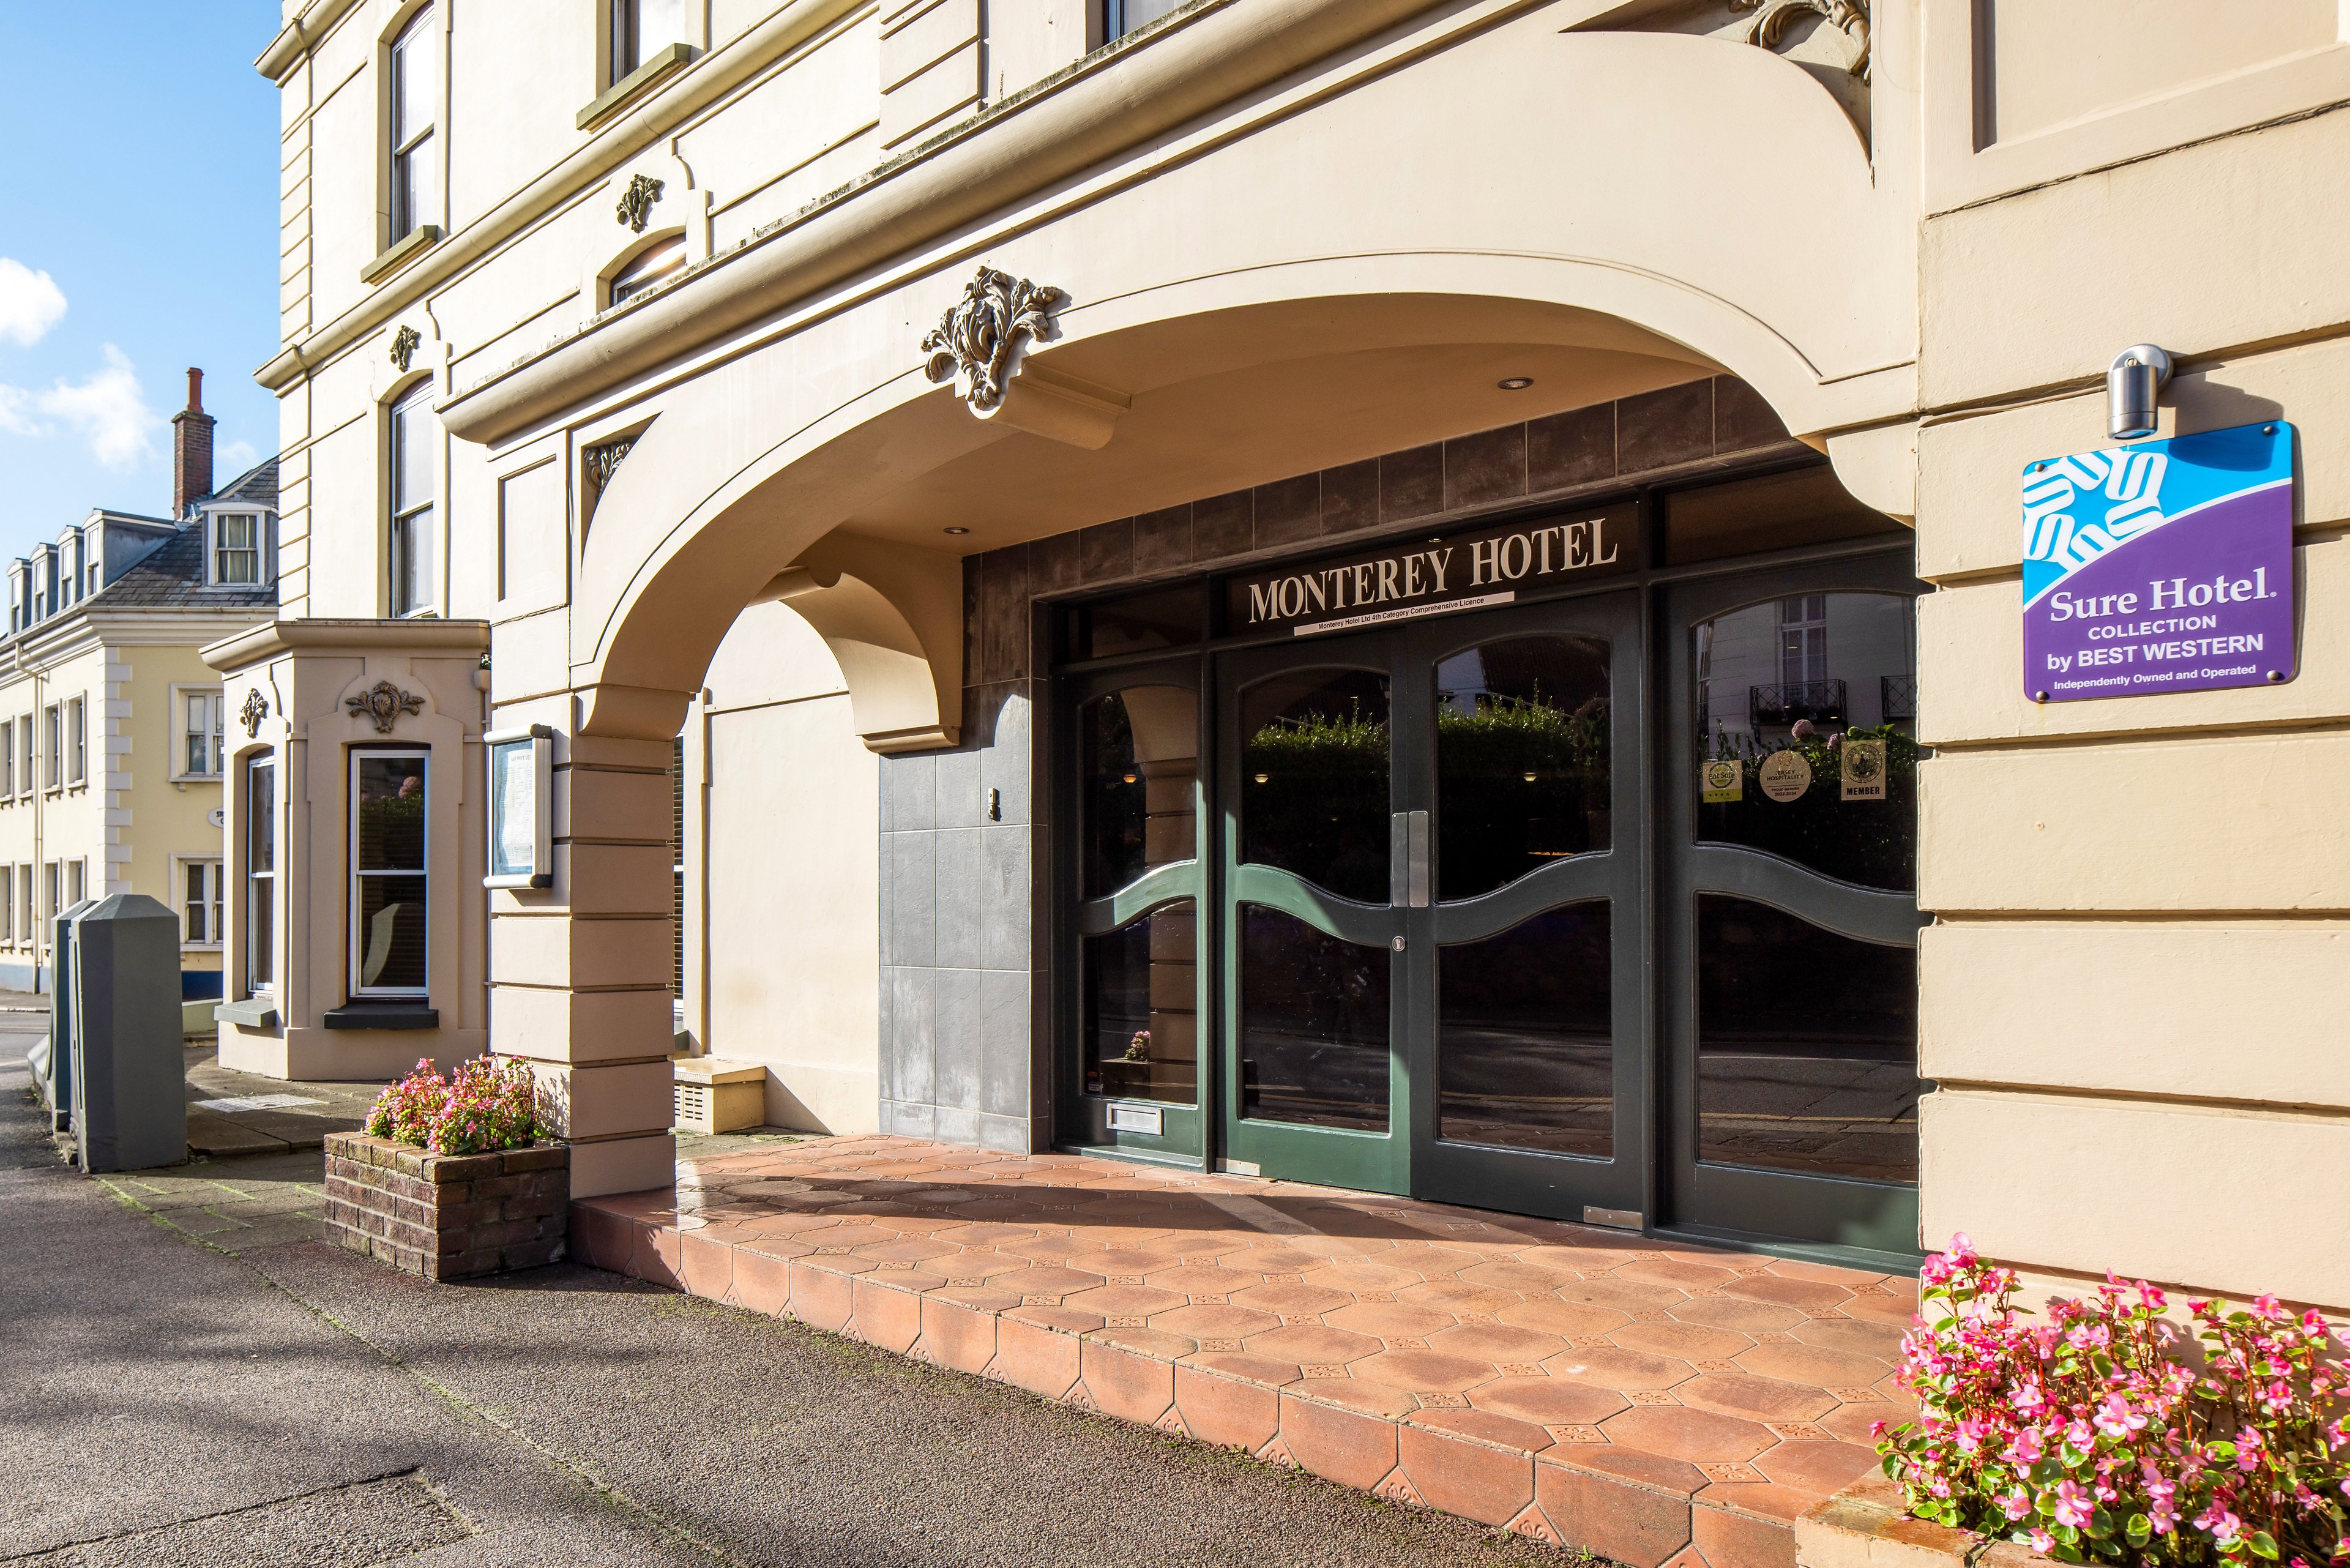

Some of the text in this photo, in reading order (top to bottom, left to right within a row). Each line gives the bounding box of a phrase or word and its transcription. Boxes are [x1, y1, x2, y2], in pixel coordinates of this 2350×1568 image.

[1249, 518, 1617, 623] MONTEREY HOTEL
[1318, 621, 1344, 630] Monterey
[1382, 609, 1409, 619] Category
[1410, 602, 1458, 615] Comprehensive
[1460, 597, 1485, 607] Licence
[2050, 592, 2138, 622] Sure
[2087, 615, 2217, 640] COLLECTION
[2047, 633, 2264, 673] by BEST WESTERN
[2054, 665, 2256, 690] Independently Owned and Operated
[1846, 786, 1880, 795] MEMBER
